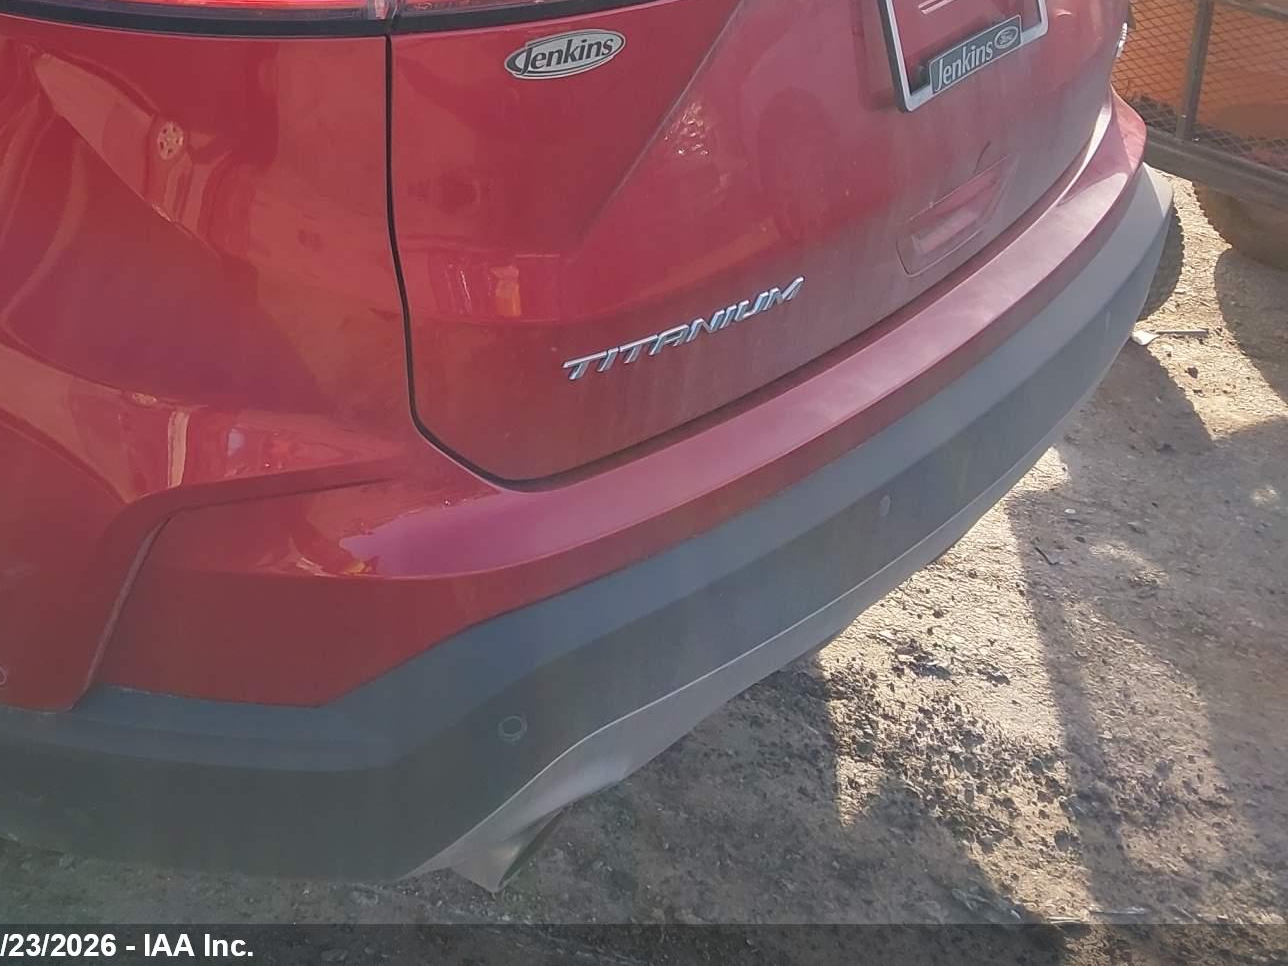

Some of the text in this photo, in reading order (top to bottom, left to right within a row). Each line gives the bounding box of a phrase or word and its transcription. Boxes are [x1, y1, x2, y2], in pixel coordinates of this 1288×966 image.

[516, 38, 614, 75] Jenkins
[934, 41, 994, 92] Jenkins
[562, 275, 806, 381] TITANIUM
